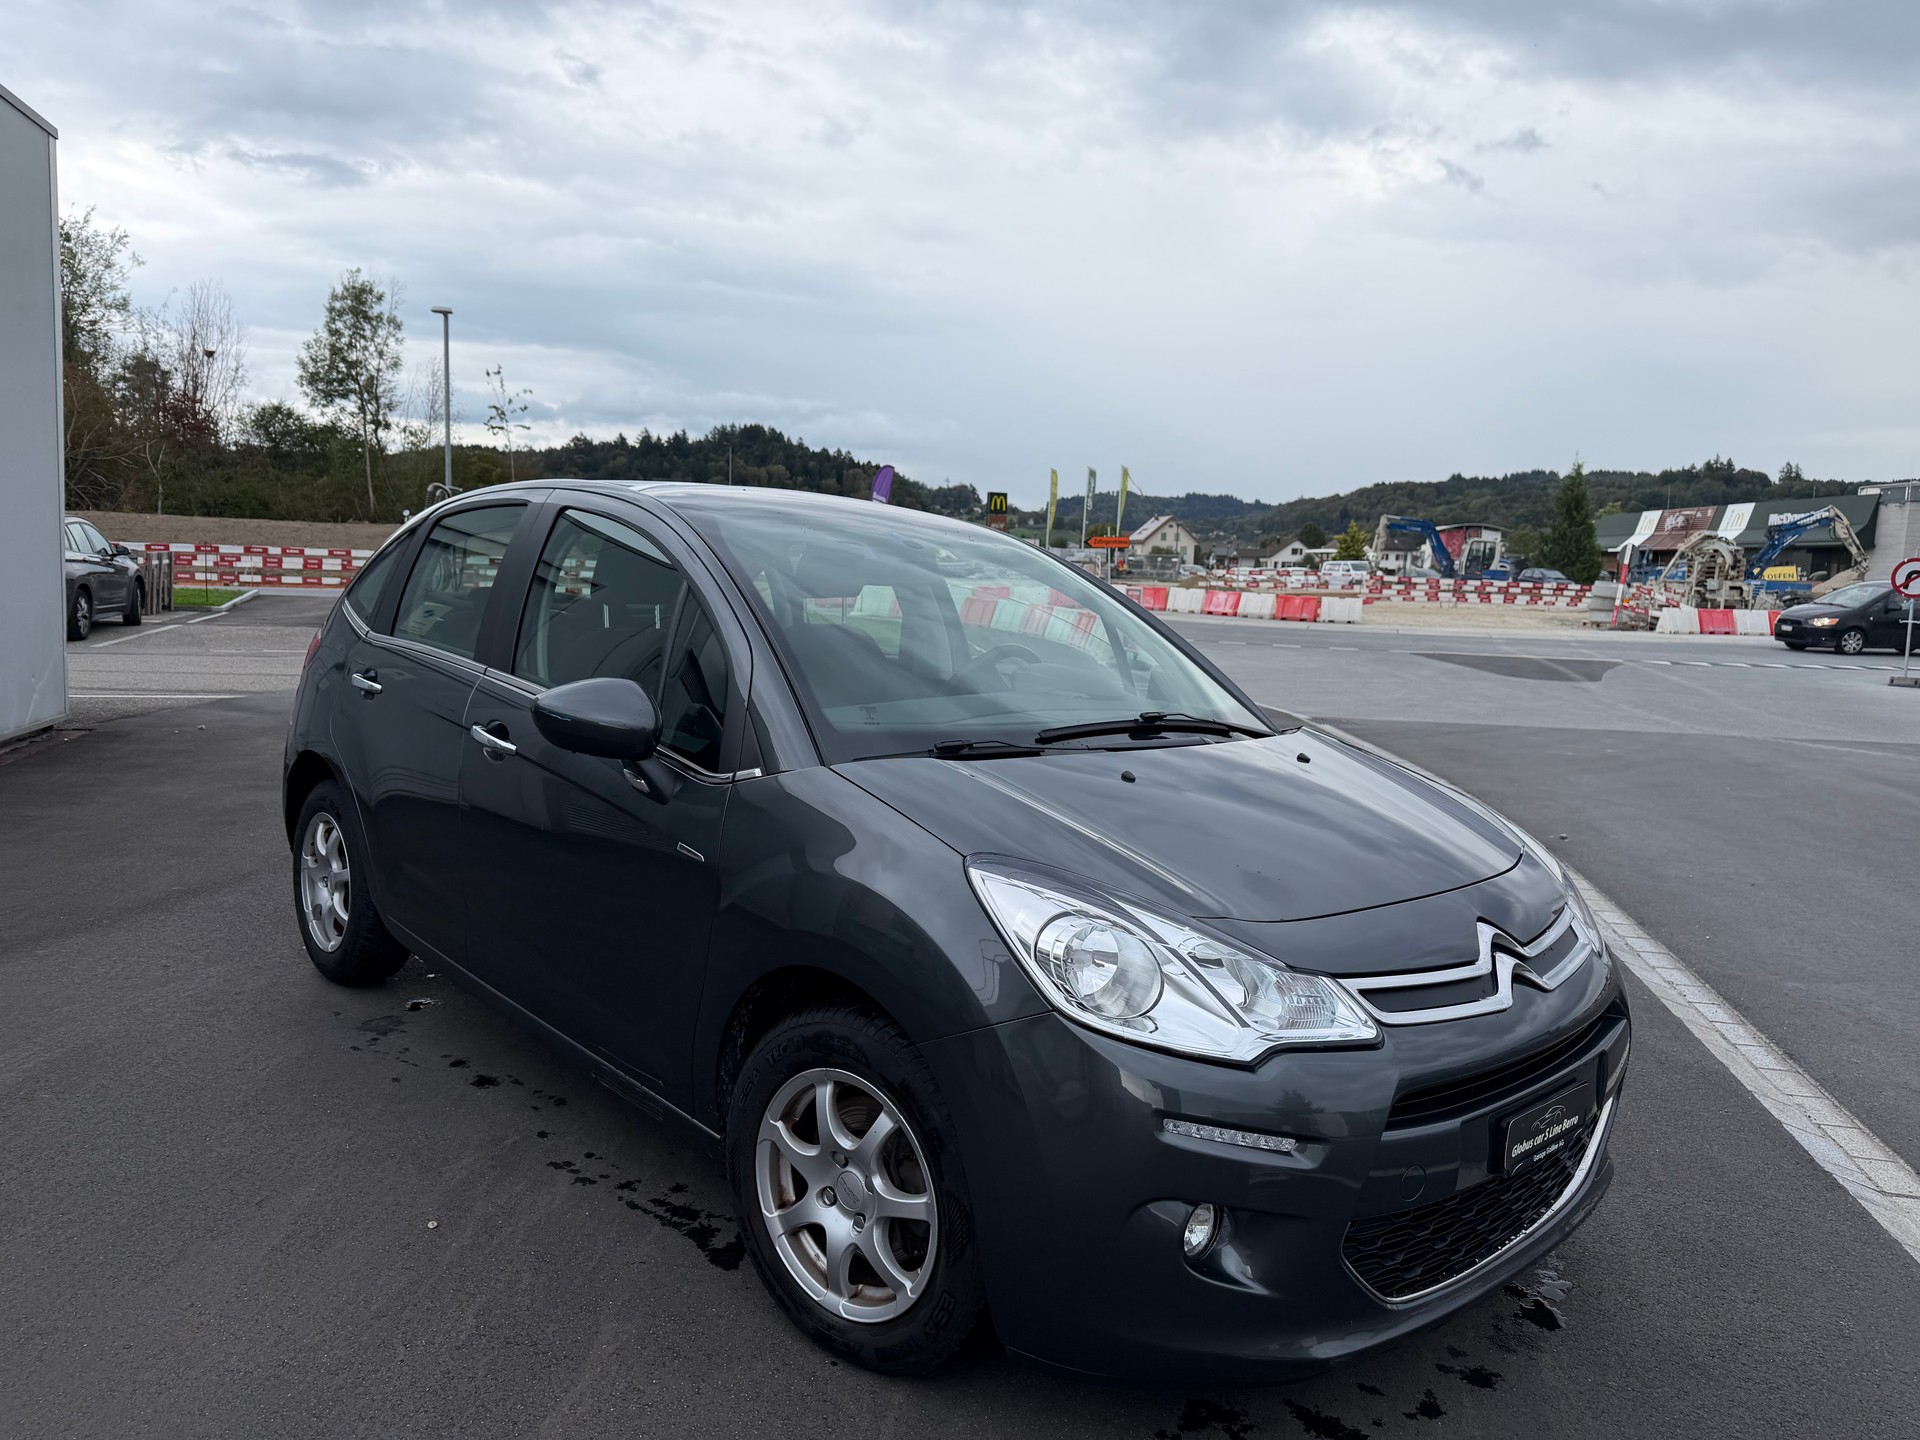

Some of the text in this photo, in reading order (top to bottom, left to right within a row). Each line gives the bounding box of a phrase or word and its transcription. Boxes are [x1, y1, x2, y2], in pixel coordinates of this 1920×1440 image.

[1511, 1138, 1534, 1158] Globus
[1534, 1133, 1545, 1146] car
[1549, 1123, 1563, 1138] Line
[1562, 1115, 1579, 1131] Berro
